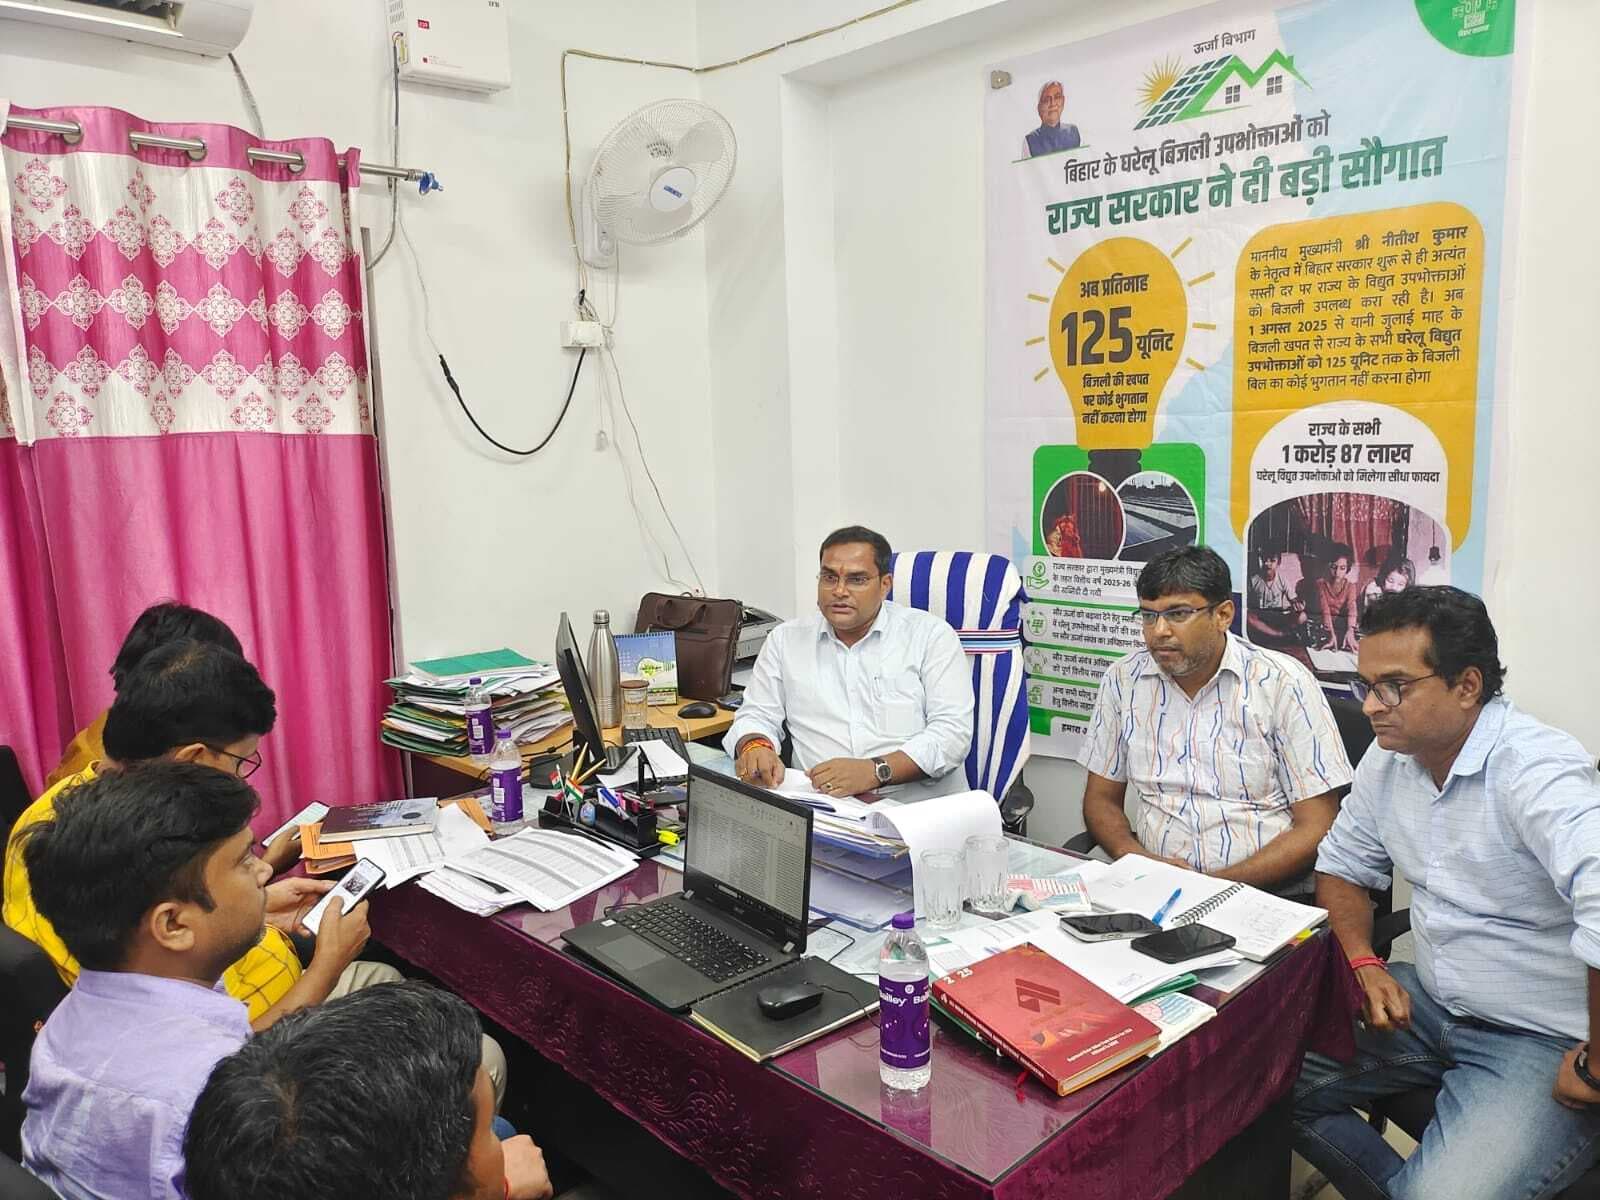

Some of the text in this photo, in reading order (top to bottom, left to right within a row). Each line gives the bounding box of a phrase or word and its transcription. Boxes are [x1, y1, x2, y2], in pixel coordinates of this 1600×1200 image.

[1193, 29, 1257, 54] ऊर्जा विभाग
[1064, 109, 1331, 184] बिहार के घरेलू बिजली उपभोक्ताओं को
[1045, 135, 1448, 236] राज्य सरकार ने दी बड़ी सौगात
[1250, 226, 1468, 262] माननीय मुख्यमंत्री श्री नीतीश कुमार
[1250, 245, 1466, 283] के नेतृत्व में बिहार सरकार शुरू से ही अत्यंत
[1080, 272, 1150, 298] अब प्रतिमाह
[1249, 263, 1466, 299] सस्ती दर पर राज्य के विद्युत उपभोक्ताओं
[1248, 303, 1262, 317] को
[1271, 299, 1305, 316] बिजली
[1313, 298, 1352, 312] उपलब्ध
[1361, 295, 1383, 308] करा
[1392, 289, 1410, 306] रही
[1444, 288, 1465, 302] अब
[1249, 305, 1464, 336] 1 अगस्त 2025 से यानी जुलाई माह के
[1061, 306, 1175, 367] 125 यूनिट
[1248, 327, 1462, 354] बिजली खपत से राज्य के सभी घरेलू विद्युत
[1248, 346, 1461, 372] उपभोक्ताओं को 125 यूनिट तक के बिजली
[1083, 371, 1150, 389] बिजली की खपत
[1248, 368, 1431, 391] बिल का कोई भुगतान नहीं करना होगा
[1083, 390, 1148, 409] पर कोई भुगतान
[1082, 407, 1147, 424] नहीं करना होगा
[1308, 418, 1382, 437] राज्य के सभी
[1282, 439, 1414, 468] 1 करोड़ 87 लाख
[1256, 468, 1276, 484] घरेलू
[1277, 468, 1297, 484] विद्युत
[1343, 469, 1354, 482] को
[1356, 468, 1387, 482] मिलेगा
[1388, 468, 1410, 482] सीधा
[1411, 471, 1440, 483] फायदा
[1103, 578, 1131, 588] 2025-26
[880, 989, 908, 1007] ailley
